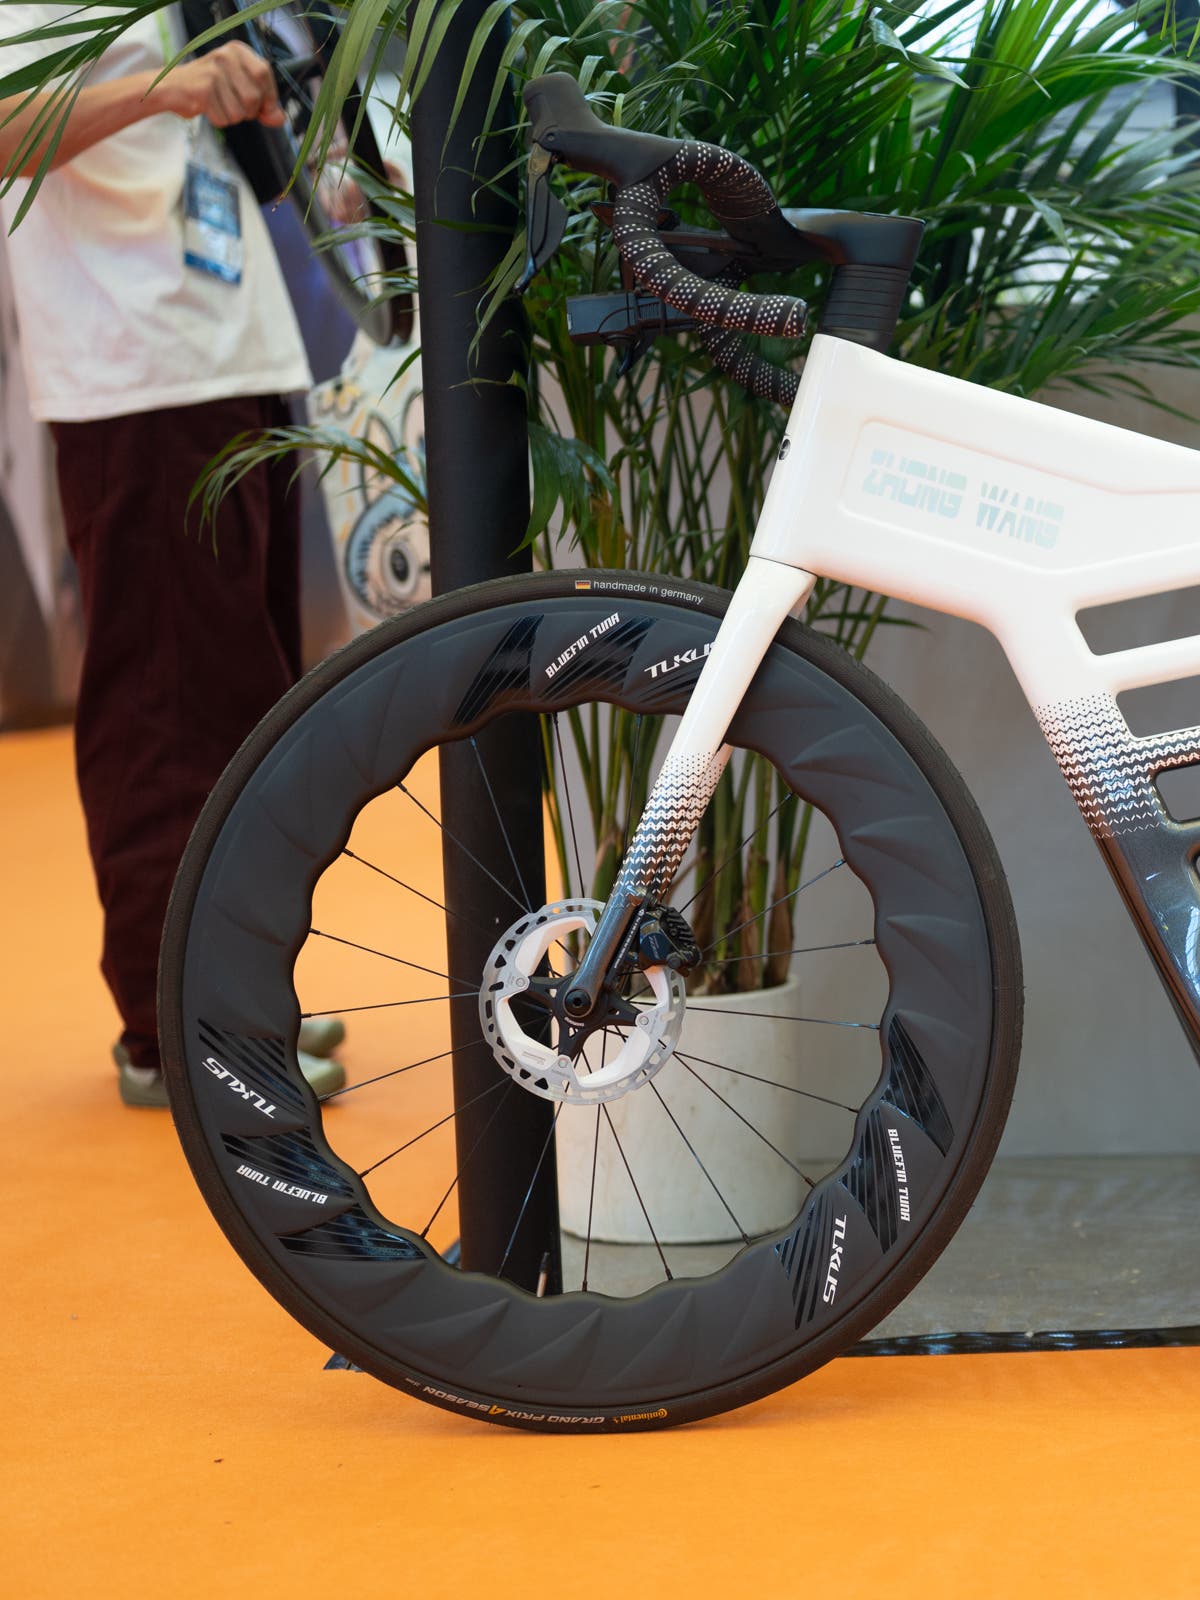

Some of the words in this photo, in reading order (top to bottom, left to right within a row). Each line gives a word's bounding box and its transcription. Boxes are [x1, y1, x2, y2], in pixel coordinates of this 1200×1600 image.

[976, 481, 1065, 549] WANG
[593, 580, 647, 593] handmade
[649, 586, 658, 595] in
[660, 587, 704, 605] germany
[545, 635, 589, 679] BLUEFIN
[589, 612, 620, 639] TUNA
[644, 640, 715, 679] TUKU
[236, 1165, 271, 1186] TUNA
[888, 1128, 908, 1183] BLUEFIN
[898, 1186, 911, 1222] TUNA
[272, 1180, 328, 1205] BLUEFIN
[548, 1414, 606, 1425] GRAND
[621, 1408, 668, 1424] Continental
